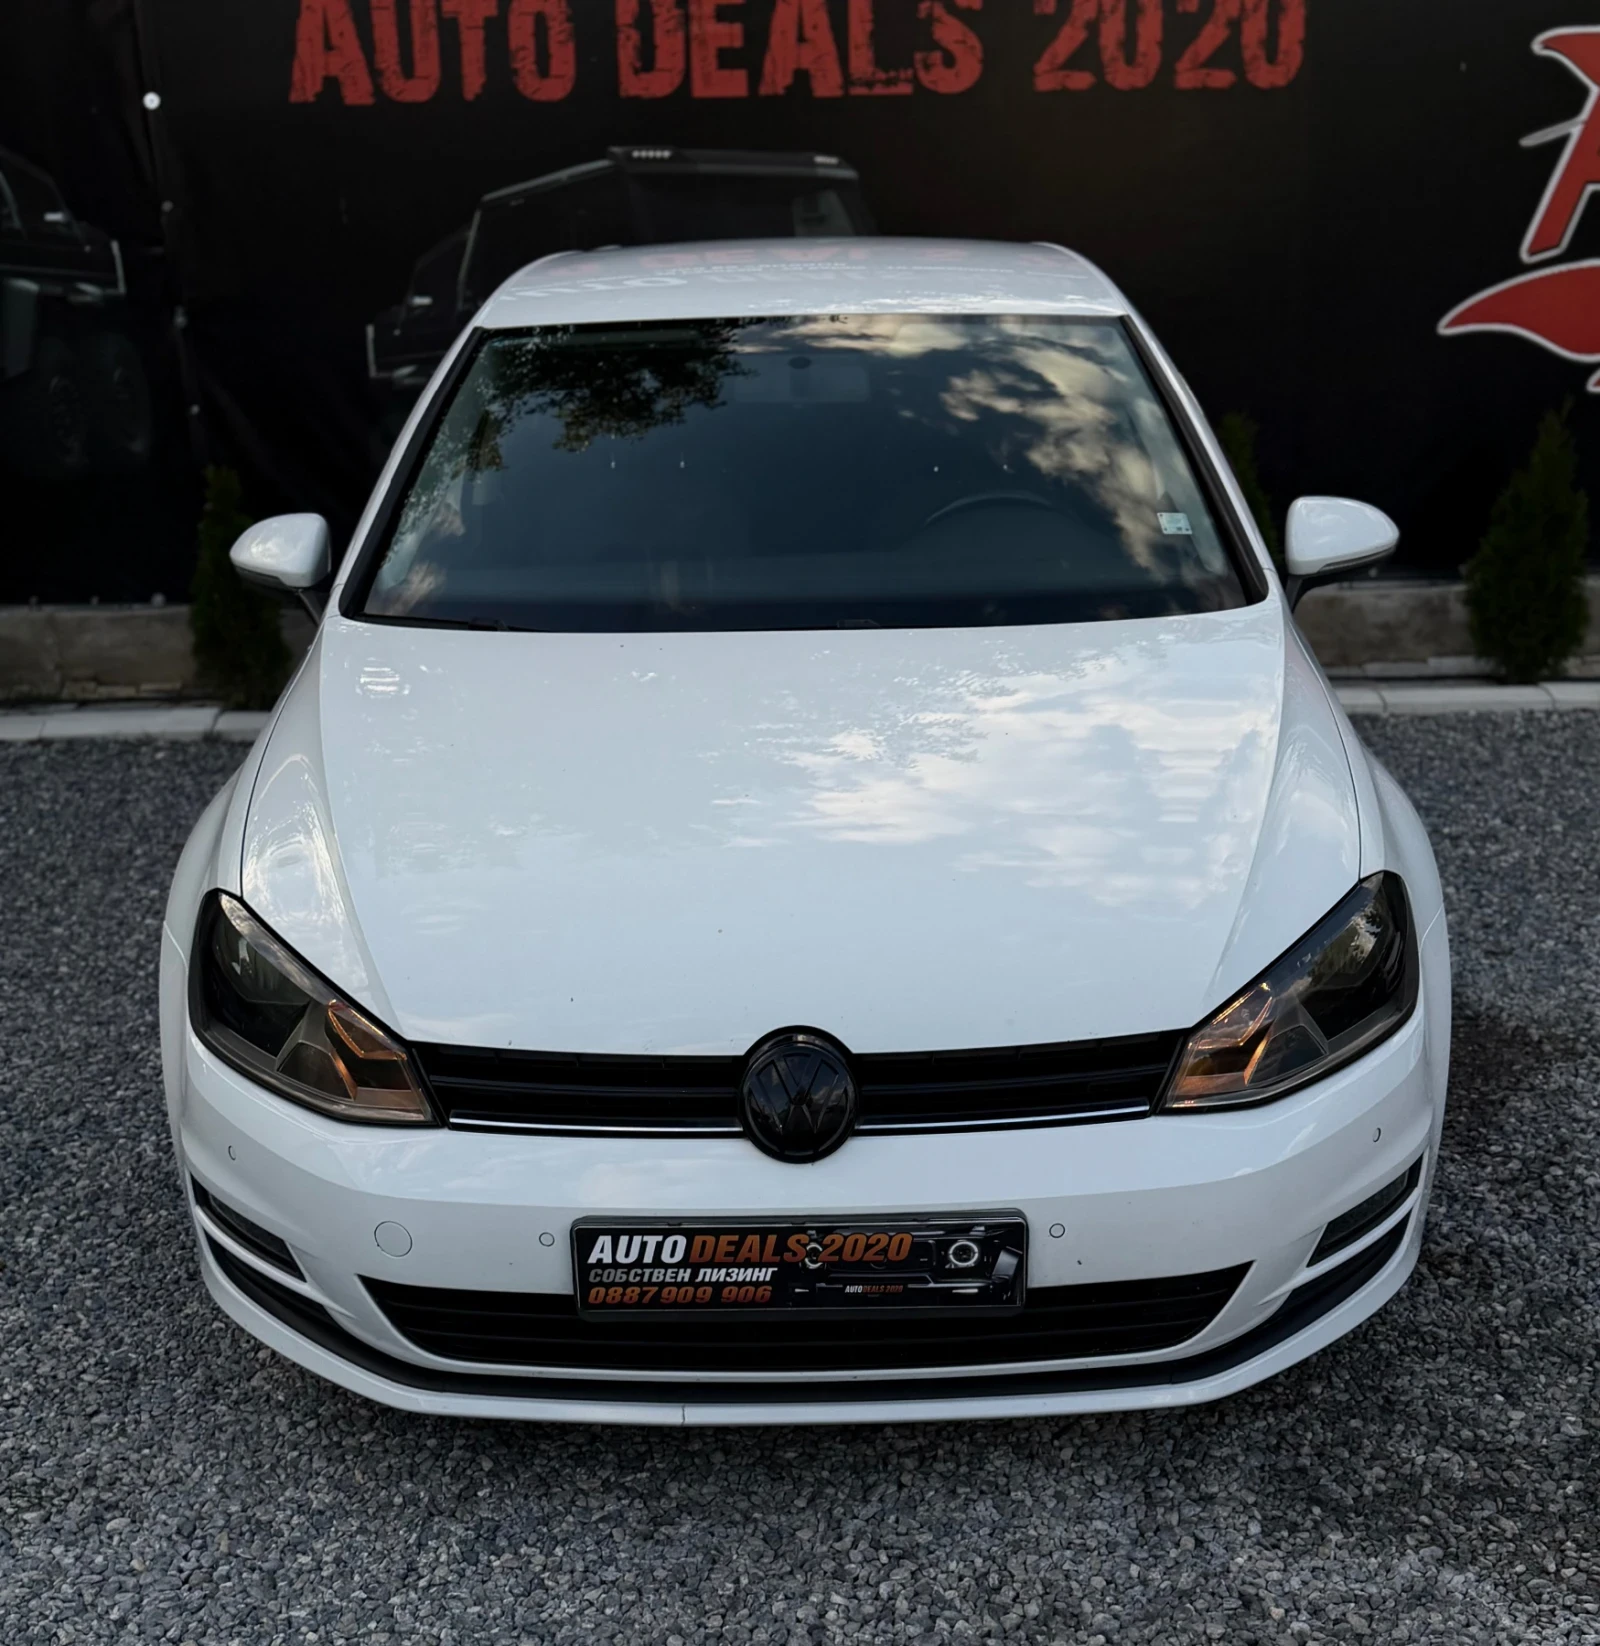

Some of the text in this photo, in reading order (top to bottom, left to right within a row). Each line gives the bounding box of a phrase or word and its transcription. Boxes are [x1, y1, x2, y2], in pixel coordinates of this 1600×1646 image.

[289, 0, 1306, 105] AUTO DEALS 2020
[587, 1232, 914, 1264] AUTO DEALS 2020
[588, 1267, 778, 1283] СОБСТВЕН ЛИЗИНГ
[588, 1285, 773, 1304] 0887 909 906
[844, 1284, 904, 1293] AUTO DEALS 2020
